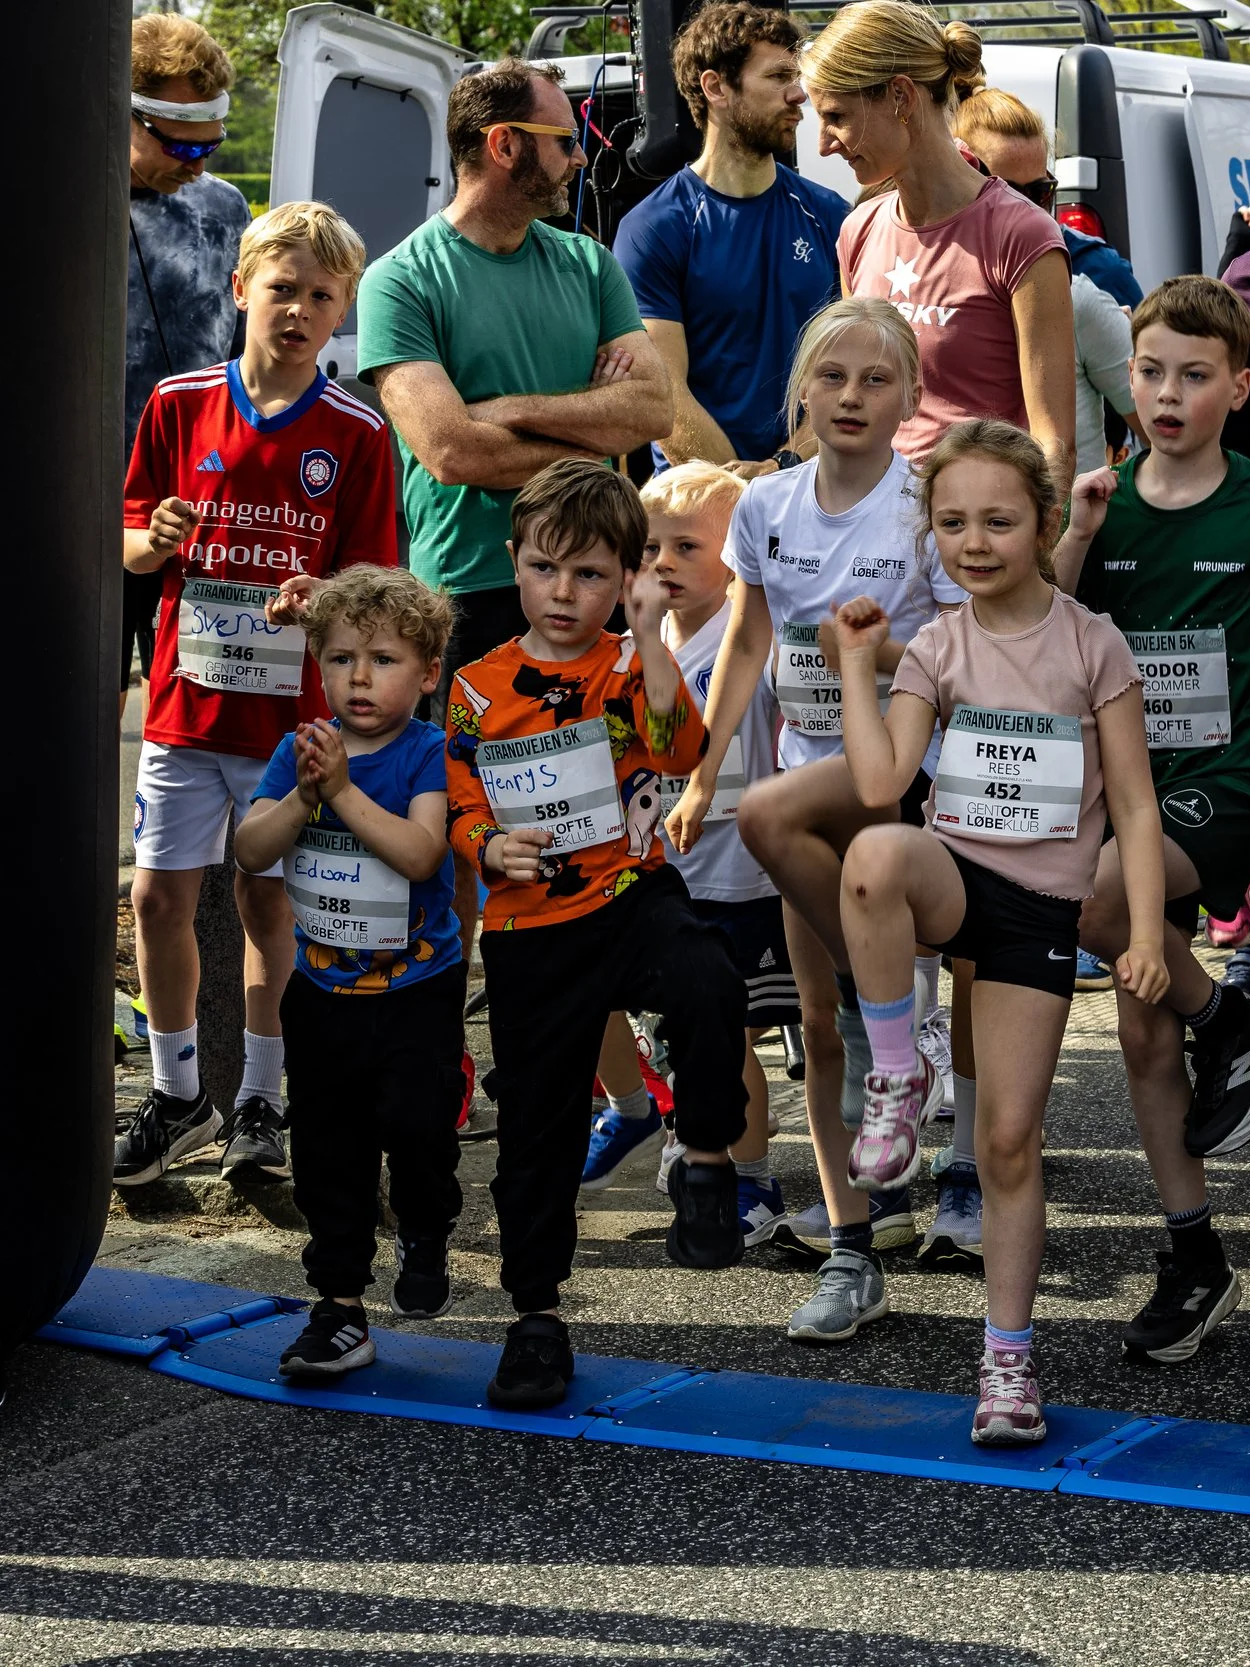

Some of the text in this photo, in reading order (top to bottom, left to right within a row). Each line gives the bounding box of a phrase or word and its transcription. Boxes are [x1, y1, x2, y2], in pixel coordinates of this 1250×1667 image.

[189, 542, 309, 574] apotek
[853, 557, 905, 569] GENTOFTE
[853, 567, 905, 580] LØBEKLUB
[193, 583, 266, 604] STRANDVEJEN
[1180, 635, 1195, 650] 5K
[222, 645, 254, 660] 546
[206, 661, 267, 677] GENTOFTE
[206, 672, 267, 688] LØBEKLUB
[1144, 699, 1172, 714] 460
[957, 709, 1033, 733] STRANDVEJEN
[1037, 717, 1054, 734] 5K
[484, 733, 561, 761] STRANDVEJEN
[563, 728, 580, 746] 5K
[976, 742, 1037, 762] FREYA
[988, 762, 1020, 775] REES
[483, 768, 536, 803] Henry
[668, 779, 689, 793] 17
[984, 782, 1022, 801] 452
[535, 800, 570, 821] 589
[967, 802, 1039, 820] GENTOFTE
[967, 815, 1039, 833] LØBEKLUB
[295, 856, 360, 882] Edward
[318, 896, 350, 913] 588
[306, 912, 368, 931] GENTOFTE
[307, 924, 368, 943] LØBEKLUB
